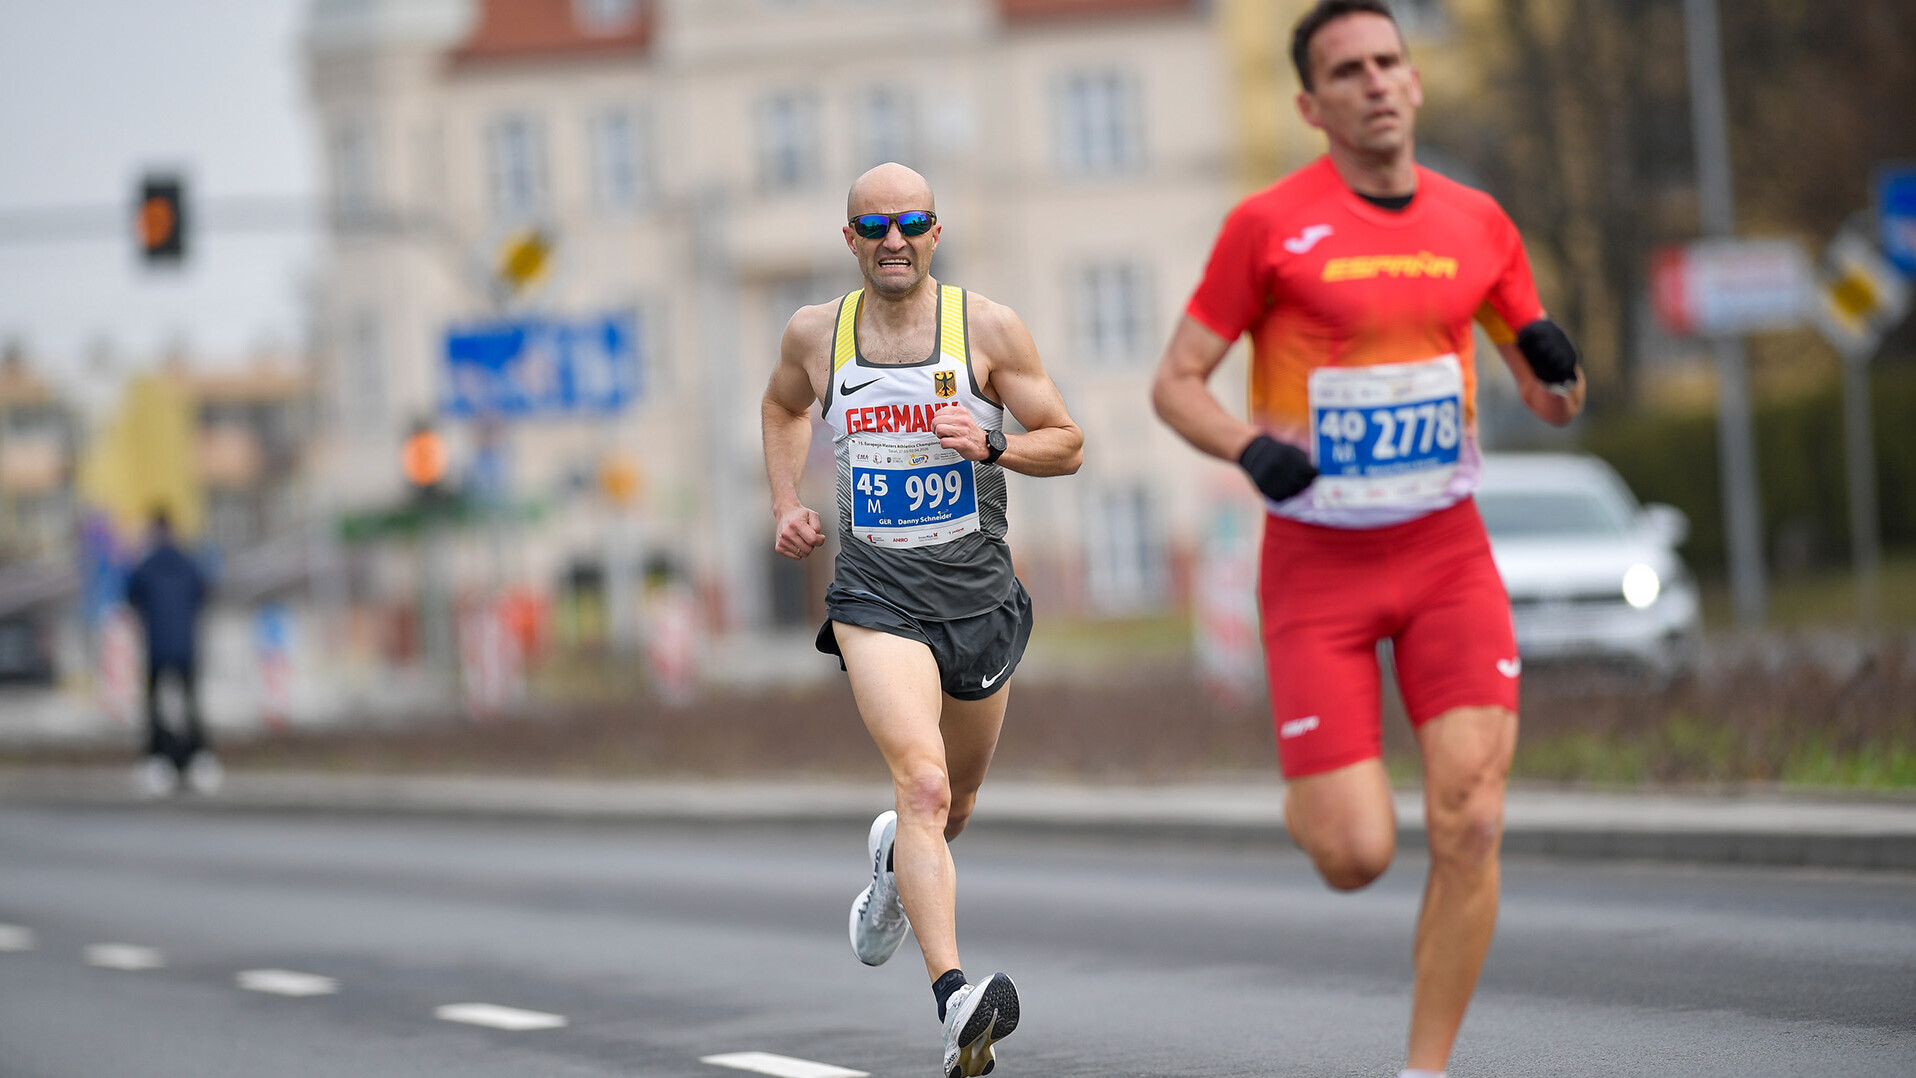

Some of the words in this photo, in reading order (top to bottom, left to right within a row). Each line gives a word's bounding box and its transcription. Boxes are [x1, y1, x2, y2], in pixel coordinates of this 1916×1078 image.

[1322, 250, 1458, 282] ESPAÑA
[845, 402, 958, 435] GERMAN
[1320, 410, 1366, 442] 40
[1371, 400, 1457, 460] 2778
[857, 473, 888, 496] 45
[905, 470, 962, 511] 999
[898, 518, 919, 526] Danny
[920, 513, 952, 523] Schneider
